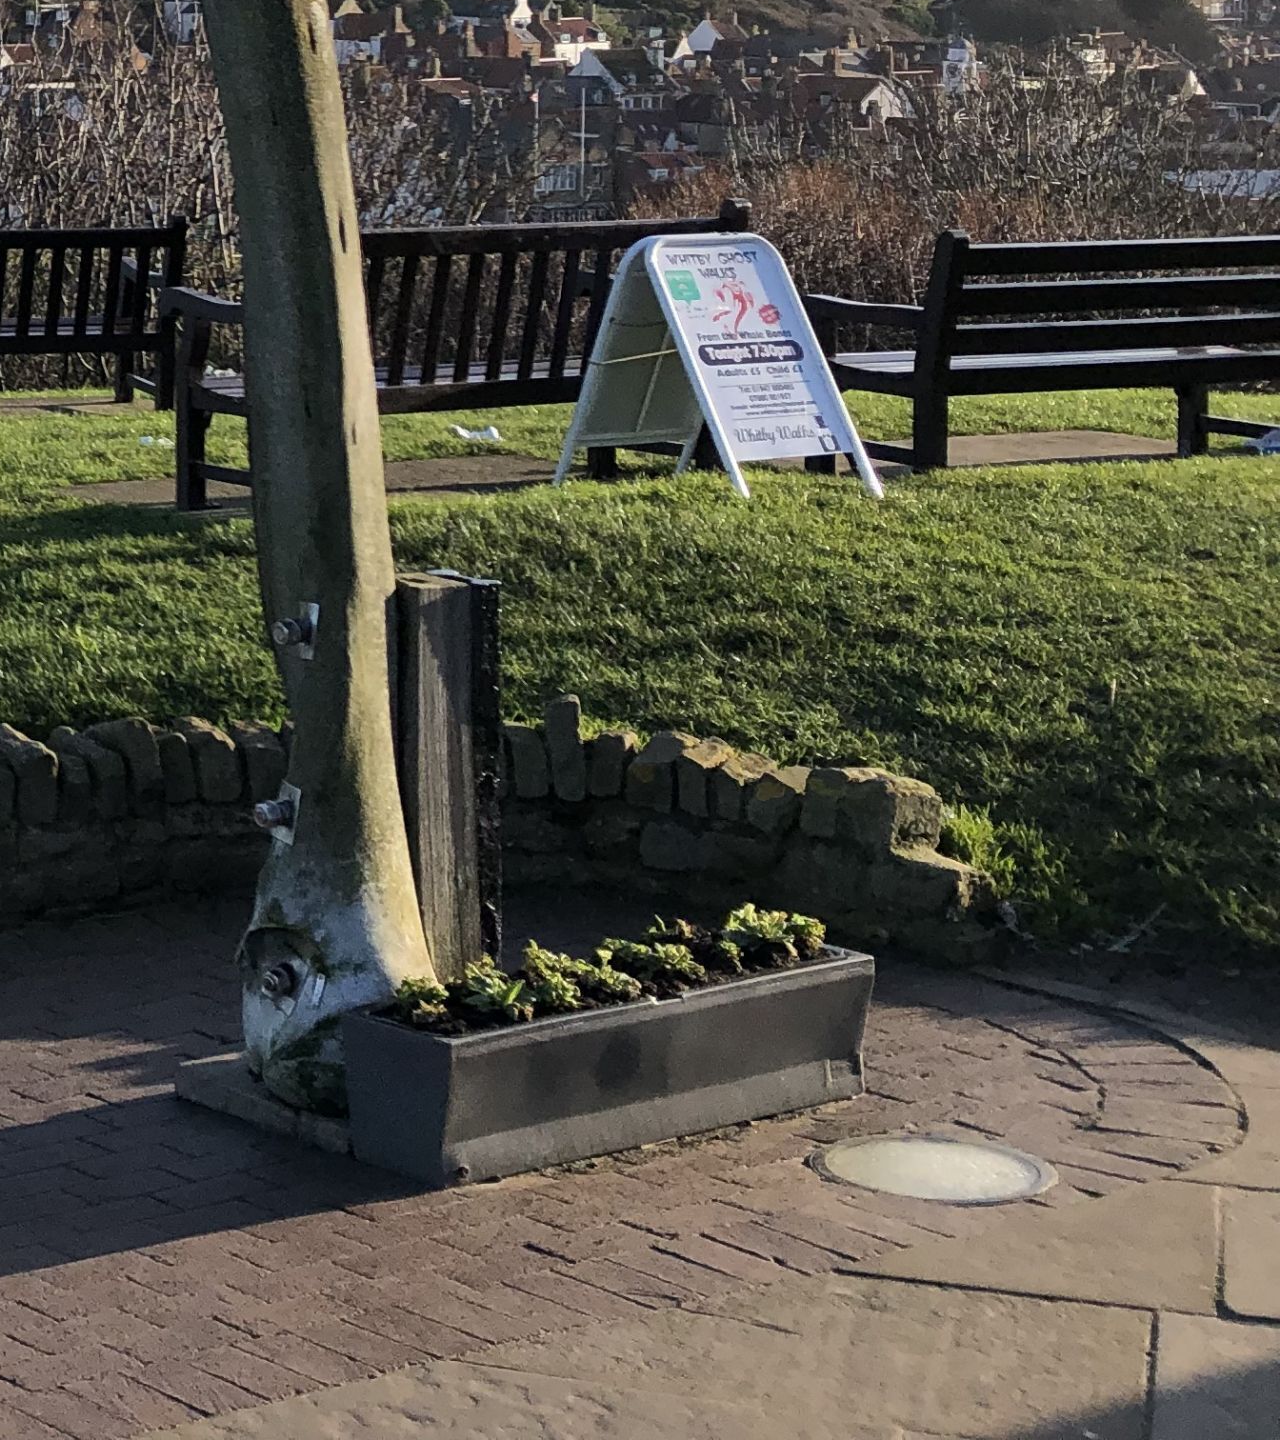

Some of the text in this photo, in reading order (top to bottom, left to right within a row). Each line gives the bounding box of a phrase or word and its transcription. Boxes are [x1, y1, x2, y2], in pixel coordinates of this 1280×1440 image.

[718, 251, 757, 264] GHOST
[698, 267, 737, 279] WALKS
[705, 345, 752, 362] Tonight
[734, 426, 776, 445] Whitby
